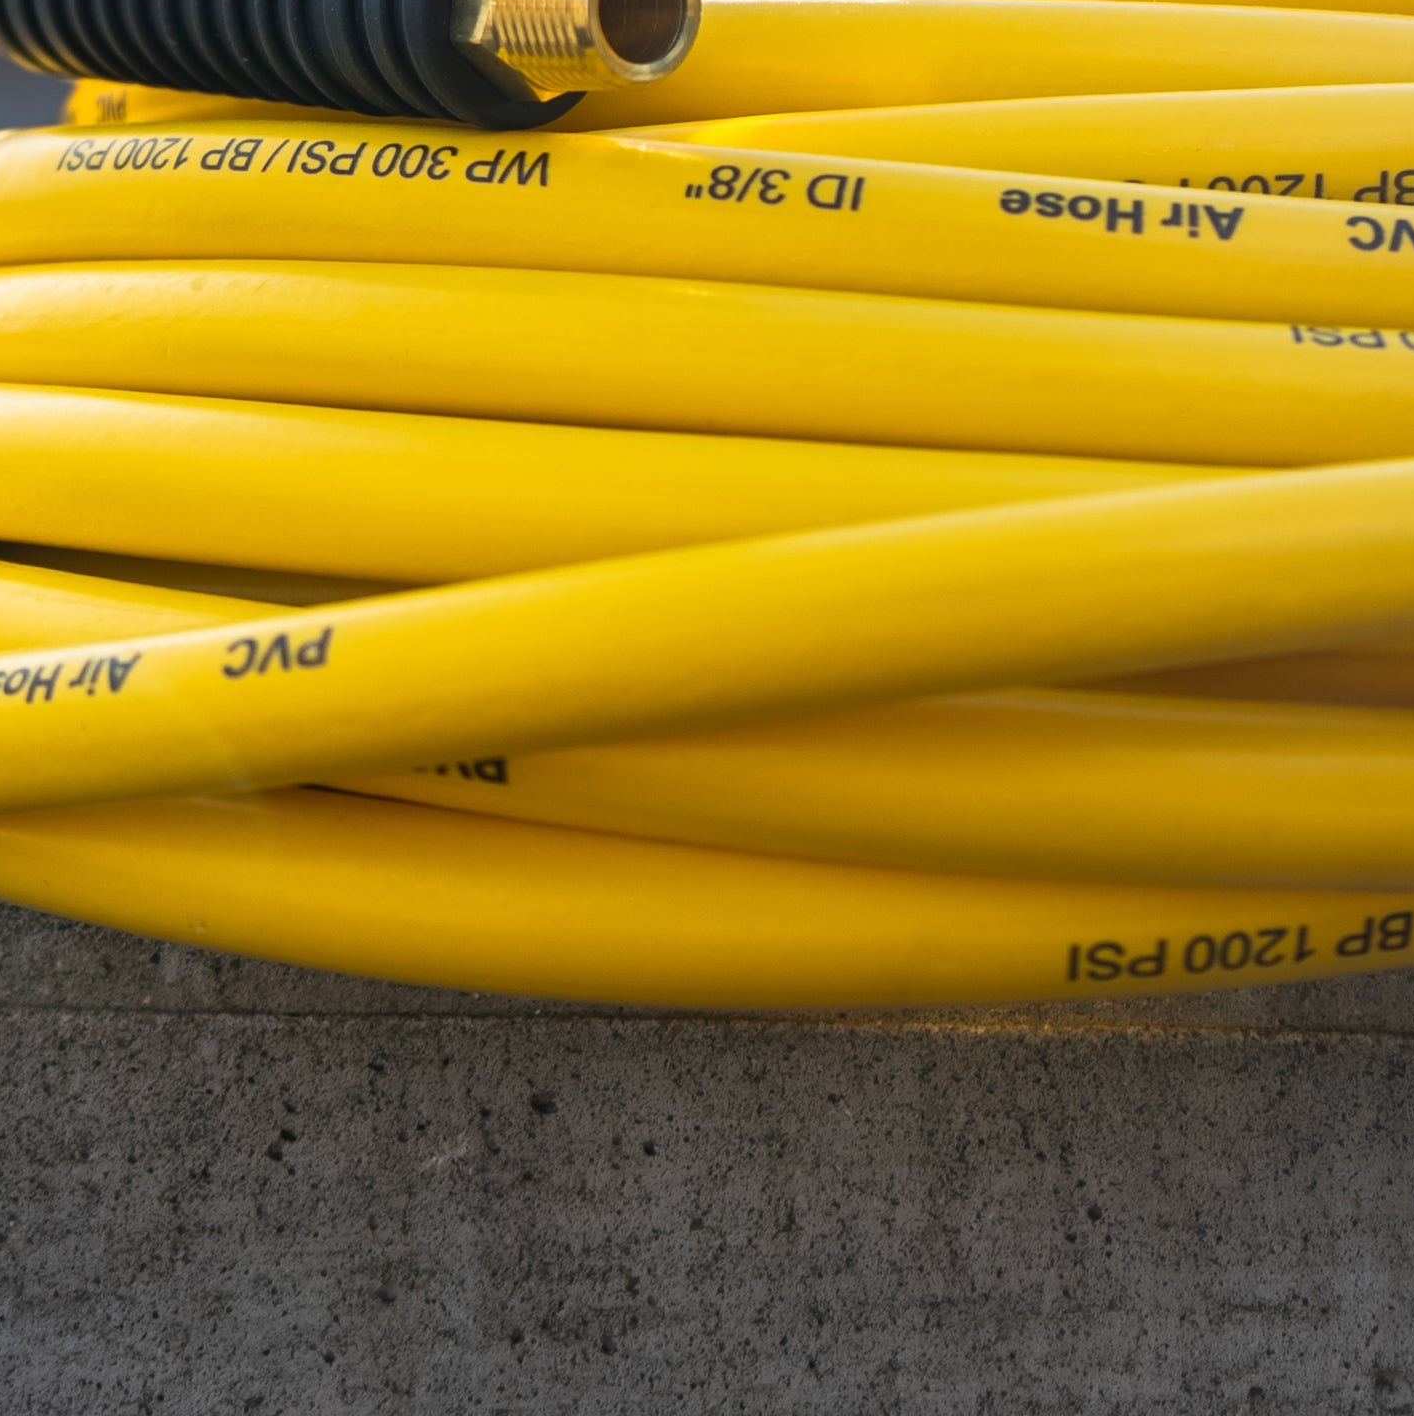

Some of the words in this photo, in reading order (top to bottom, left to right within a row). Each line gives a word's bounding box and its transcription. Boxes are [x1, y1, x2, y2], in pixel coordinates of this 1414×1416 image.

[56, 137, 119, 172] PSI
[113, 137, 194, 171] 1200
[200, 138, 264, 172] BP
[260, 138, 290, 173] /
[287, 139, 370, 176] PSI
[371, 142, 459, 181] 300
[465, 149, 551, 187] WP
[684, 164, 792, 205] 3/8"
[806, 173, 866, 212] ID
[999, 186, 1144, 234] Hose
[1160, 201, 1245, 241] Air
[1289, 323, 1386, 349] PSI
[221, 626, 334, 681] PVC
[68, 651, 143, 696] Air
[1183, 925, 1316, 974] 1200
[1334, 910, 1414, 958] BP
[1066, 938, 1167, 981] PSI
